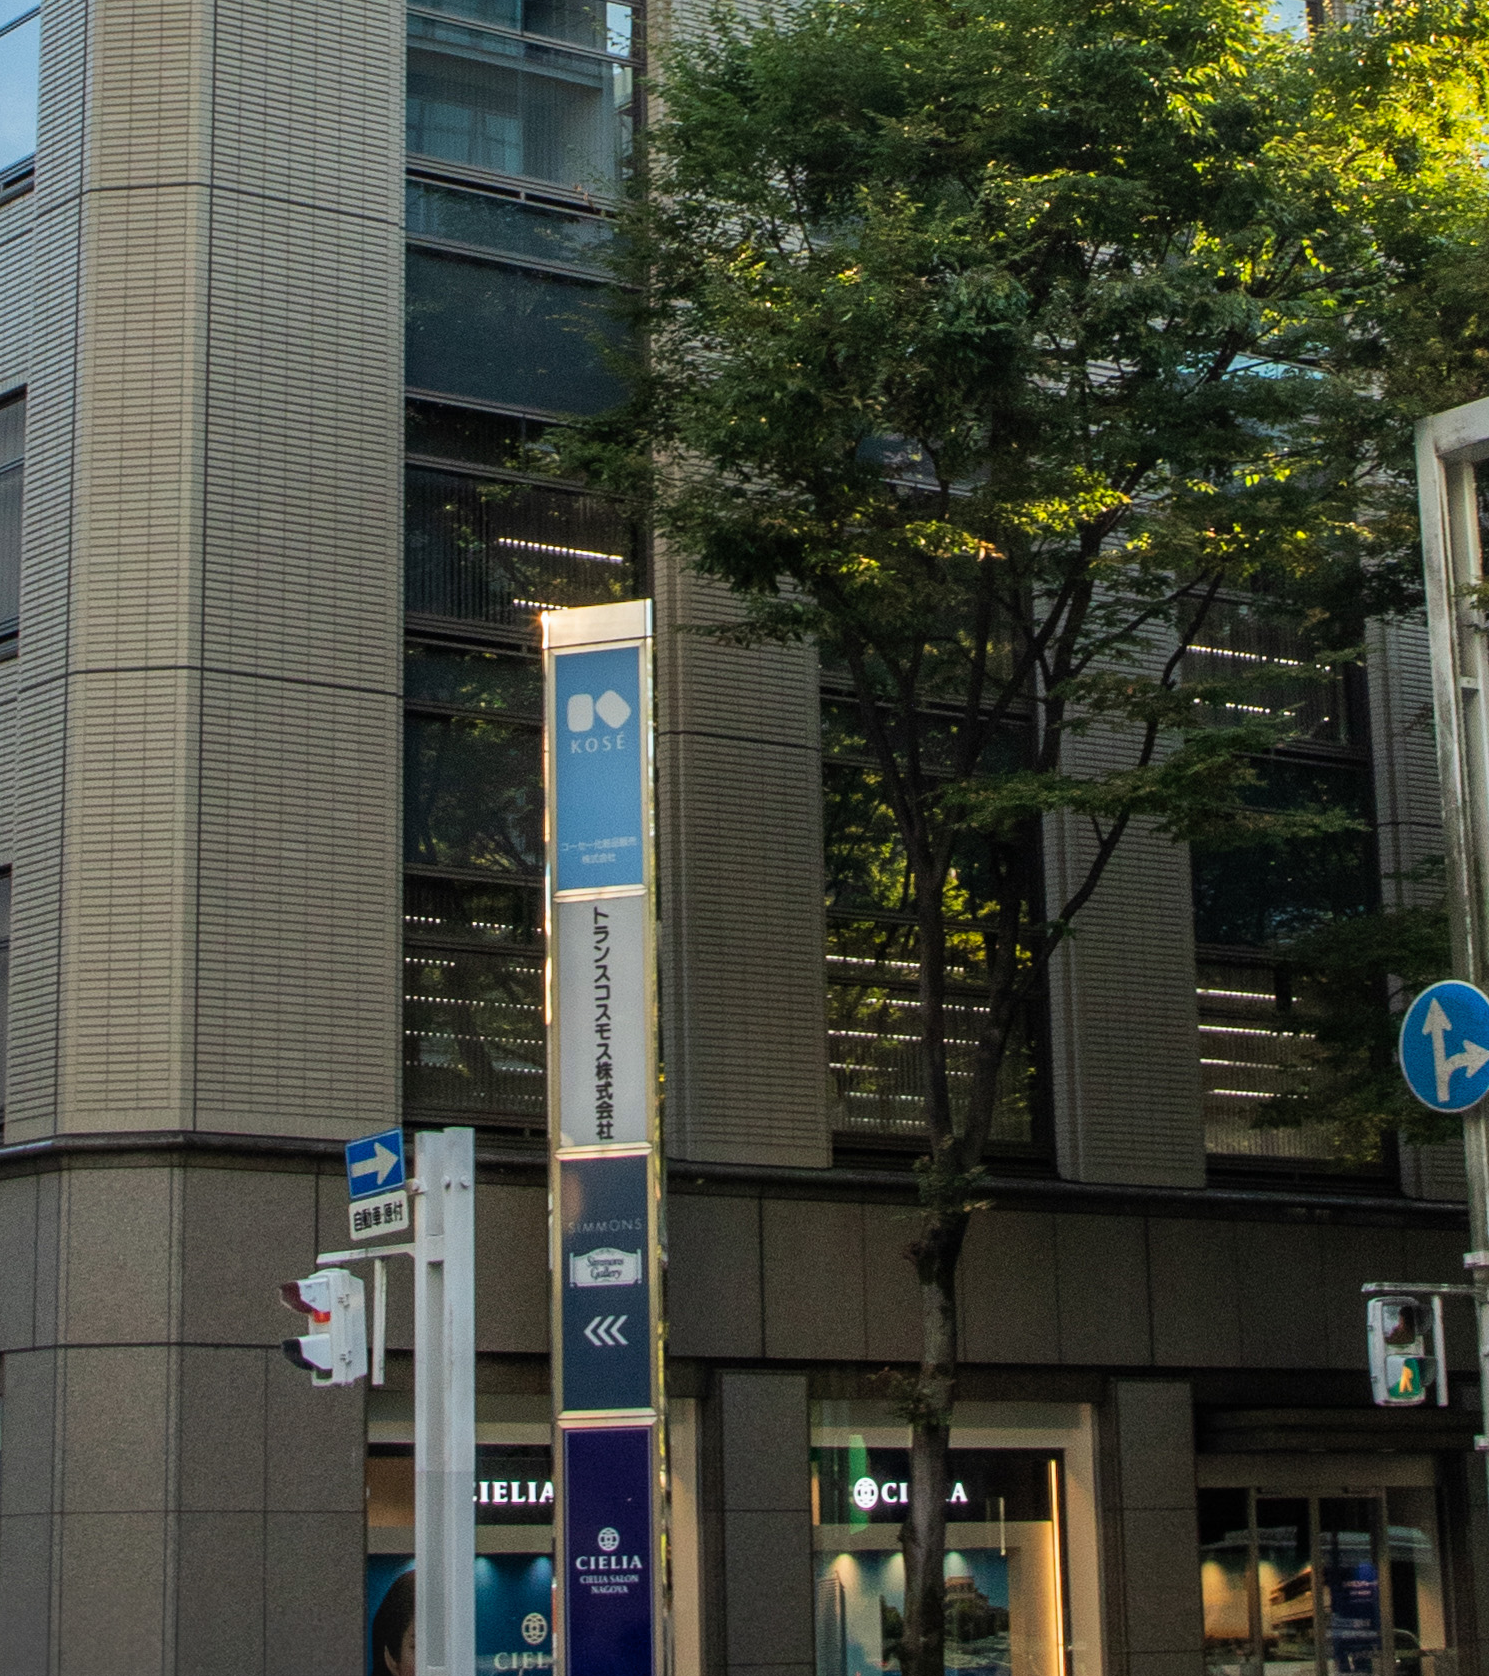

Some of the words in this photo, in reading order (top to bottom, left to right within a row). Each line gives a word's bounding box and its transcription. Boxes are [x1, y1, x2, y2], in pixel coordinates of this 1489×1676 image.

[571, 731, 626, 754] KOSÉ
[593, 906, 614, 1140] トランスコスモス株式会社
[568, 1218, 642, 1235] SIMMONS
[472, 1480, 555, 1503] IELIA
[880, 1481, 969, 1503] CIA
[575, 1554, 643, 1570] CIELIA
[579, 1574, 609, 1585] CIELIA
[610, 1573, 640, 1583] SALON
[591, 1585, 629, 1594] NAGOYA
[494, 1652, 549, 1670] CIEL
